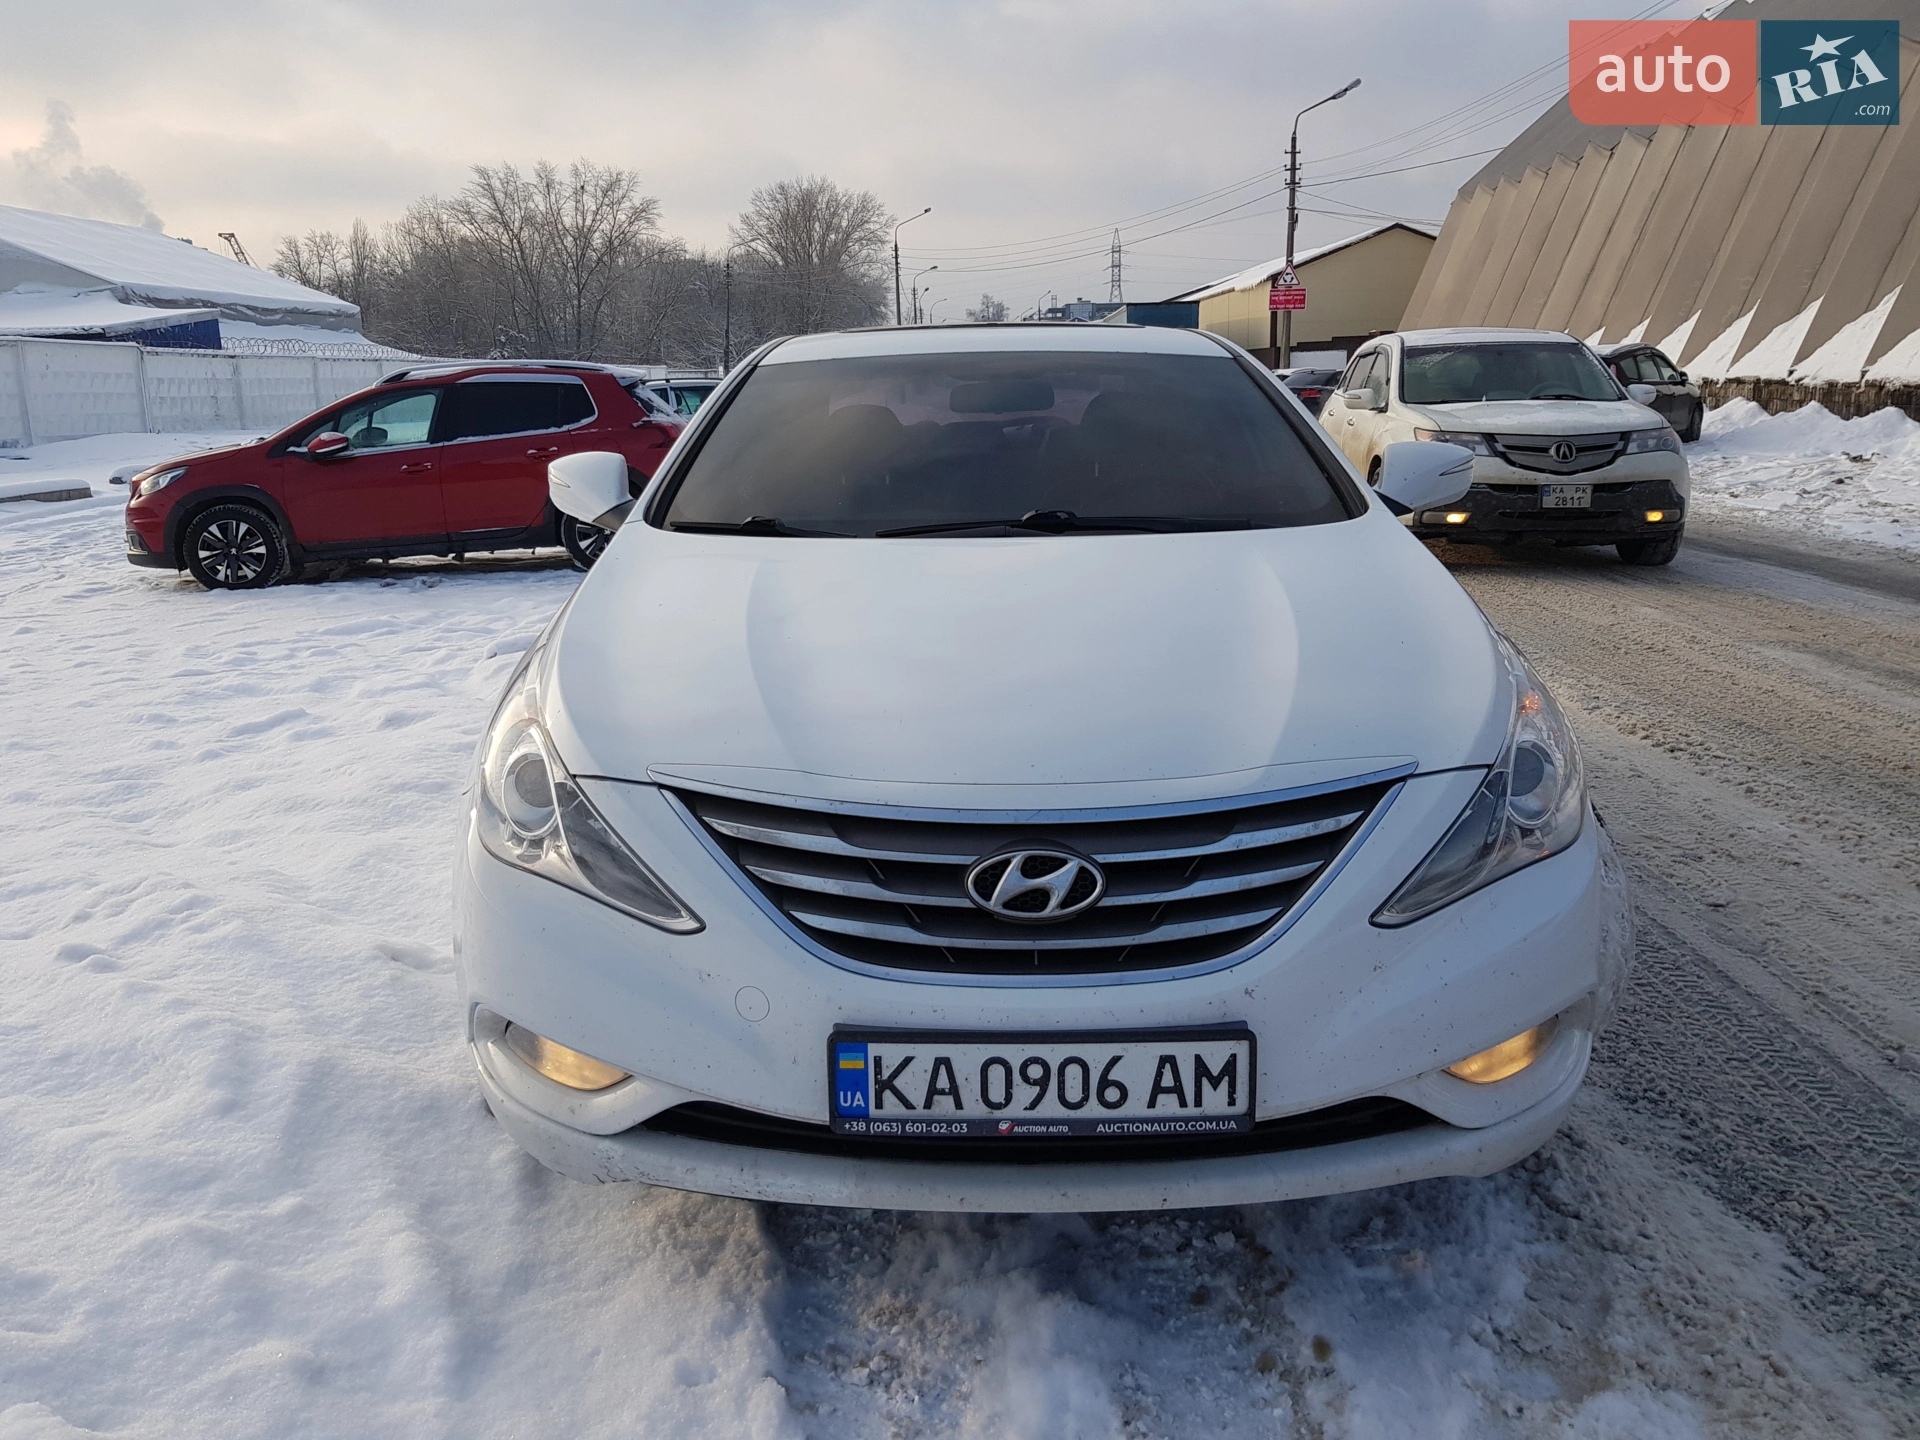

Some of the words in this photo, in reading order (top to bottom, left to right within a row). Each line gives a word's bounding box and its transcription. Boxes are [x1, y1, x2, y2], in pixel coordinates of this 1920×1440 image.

[1554, 496, 1584, 506] 2811
[873, 1055, 964, 1111] KA
[979, 1055, 1129, 1111] 0906
[1146, 1053, 1237, 1109] AM
[839, 1090, 865, 1108] UA
[844, 1121, 866, 1132] +38
[869, 1121, 902, 1134] (063)
[905, 1121, 968, 1134] 601-02-03
[1013, 1125, 1047, 1133] AUCTION
[1048, 1125, 1069, 1133] AUTO
[1096, 1119, 1237, 1133] AUCTIONAUTO.COM.UA
